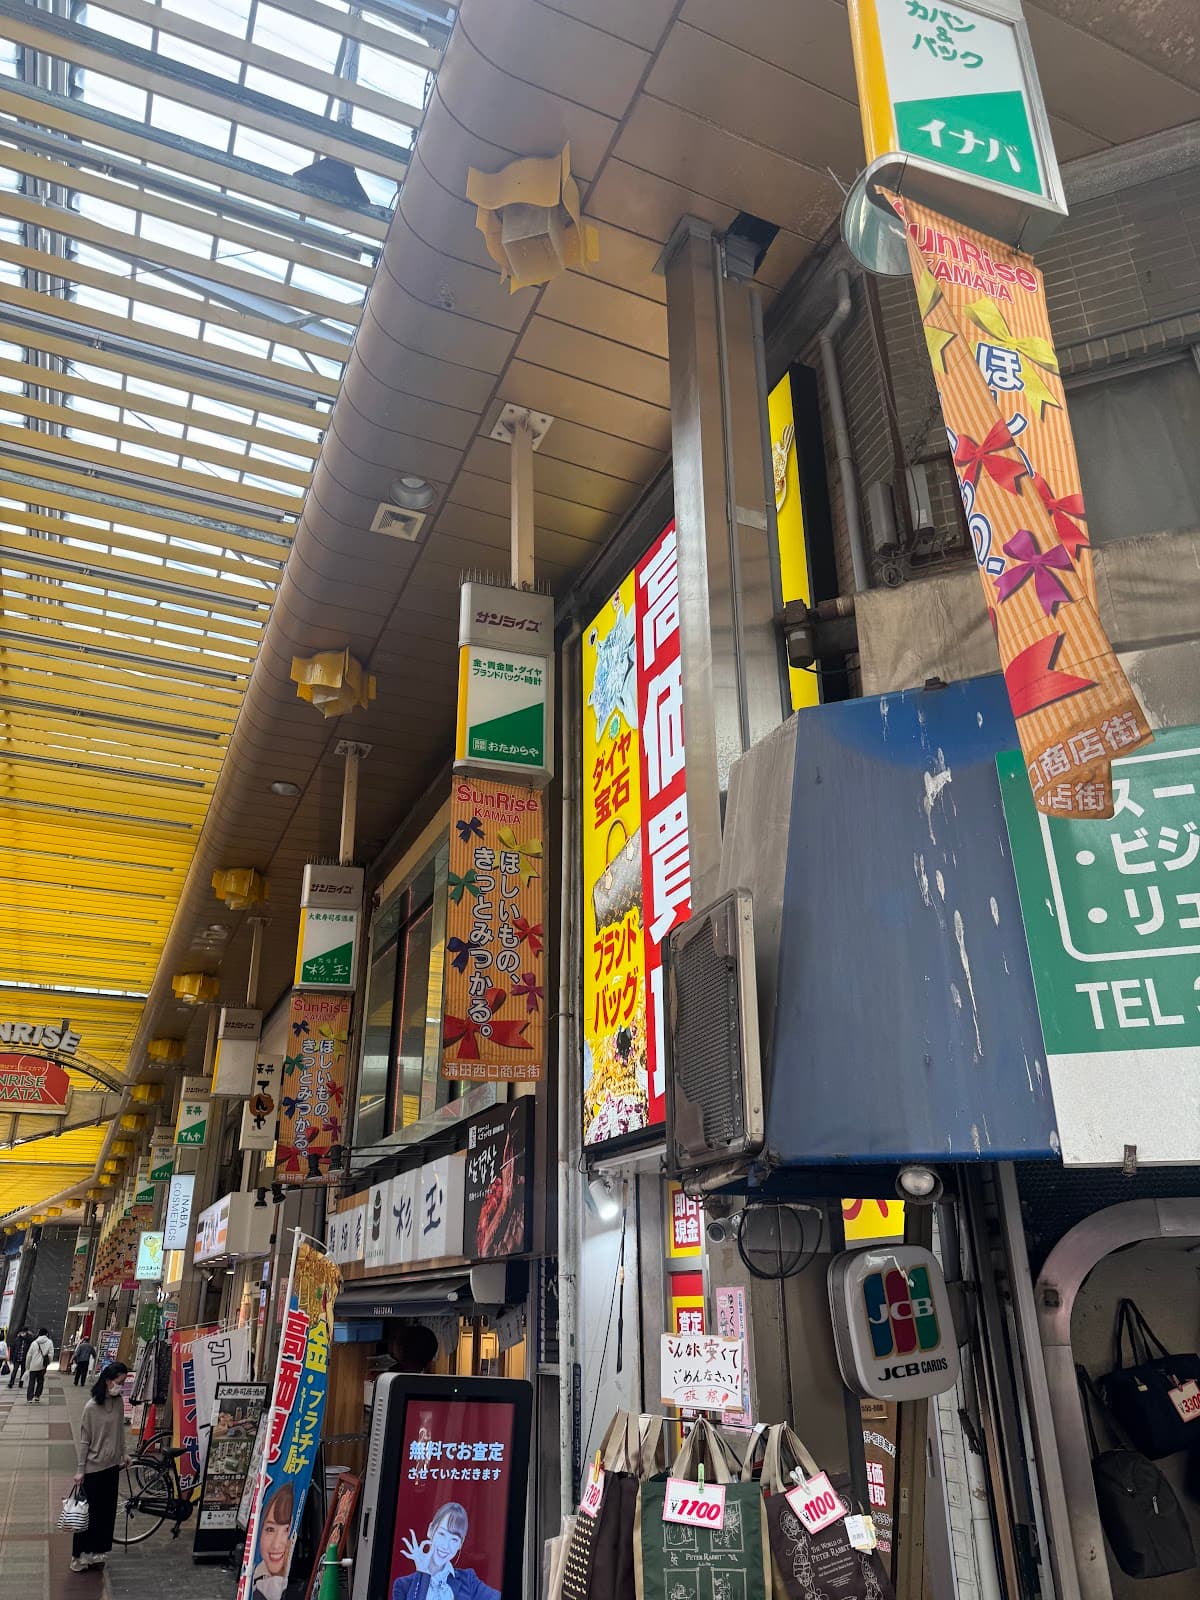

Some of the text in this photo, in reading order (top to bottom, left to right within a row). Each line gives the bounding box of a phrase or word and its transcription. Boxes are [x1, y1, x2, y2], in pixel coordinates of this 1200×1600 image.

[936, 26, 954, 45] &
[918, 119, 1021, 173] イナバ
[900, 213, 1038, 293] unRise
[472, 657, 543, 677] 金・貴金属・ダイヤ
[472, 666, 543, 687] ブランドバッグ・時計
[488, 741, 540, 758] おたからや
[592, 729, 632, 791] ダイヤ
[456, 784, 539, 813] SunRise
[594, 766, 631, 830] 宝石
[473, 806, 521, 825] KAMATA
[496, 850, 521, 984] ほしいもの、
[468, 846, 496, 1038] きっとみつかる。
[594, 916, 637, 983] ブランド
[293, 999, 350, 1014] SunRise
[593, 966, 639, 1034] バッグ
[1075, 977, 1185, 1030] TEL
[314, 1039, 335, 1124] ほしいもの、
[445, 1062, 541, 1079] 蒲田西口商店街
[293, 1038, 317, 1158] きっとみつかる。
[167, 1182, 182, 1242] COSMETICS
[178, 1194, 191, 1229] INABA
[675, 1217, 699, 1244] 現金
[679, 1311, 703, 1337] 査定
[868, 1297, 936, 1326] JCB
[878, 1357, 948, 1381] JCB CARDS
[409, 1441, 505, 1462] 無料でお査定
[407, 1467, 502, 1481] させていただきます
[671, 1499, 721, 1521] ¥1100
[802, 1490, 836, 1523] ¥1100
[685, 1552, 722, 1561] PETER RABBIT
[811, 1543, 850, 1563] PETER RABBIT
